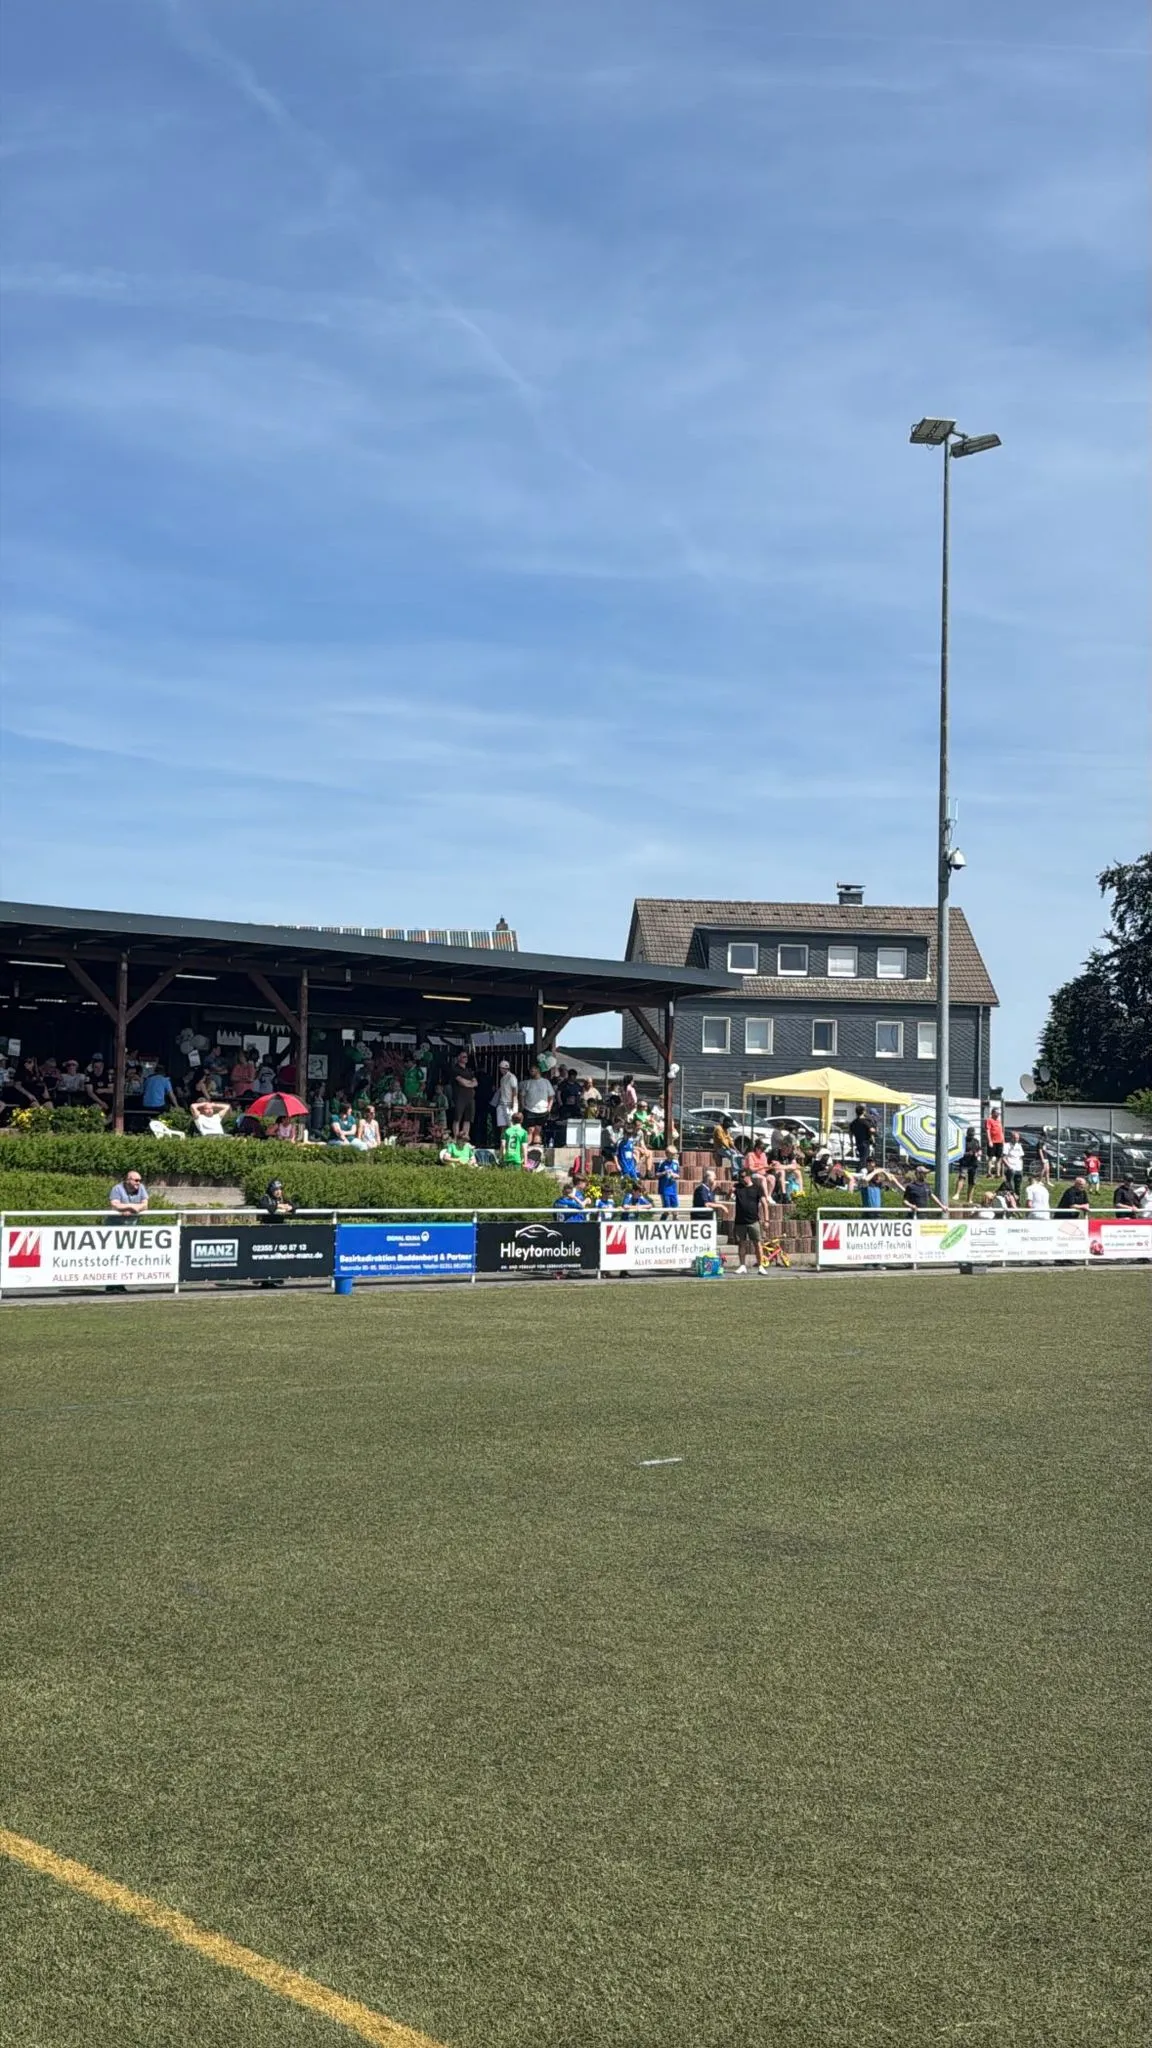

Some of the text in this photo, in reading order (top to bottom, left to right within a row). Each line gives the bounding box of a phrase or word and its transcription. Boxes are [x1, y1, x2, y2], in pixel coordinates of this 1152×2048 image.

[634, 1223, 712, 1240] MAYWEG
[846, 1222, 912, 1237] MAYWEG
[53, 1229, 172, 1251] MAYWEG
[846, 1241, 912, 1250] Kunststoff-Technik
[195, 1244, 234, 1257] MANZ
[500, 1241, 581, 1261] Hleytomobile
[634, 1244, 711, 1255] Kunststoff-Technik
[52, 1254, 172, 1268] Kunststoff-Technik
[52, 1270, 171, 1282] ALLES ANDERE IST PLASTIK
